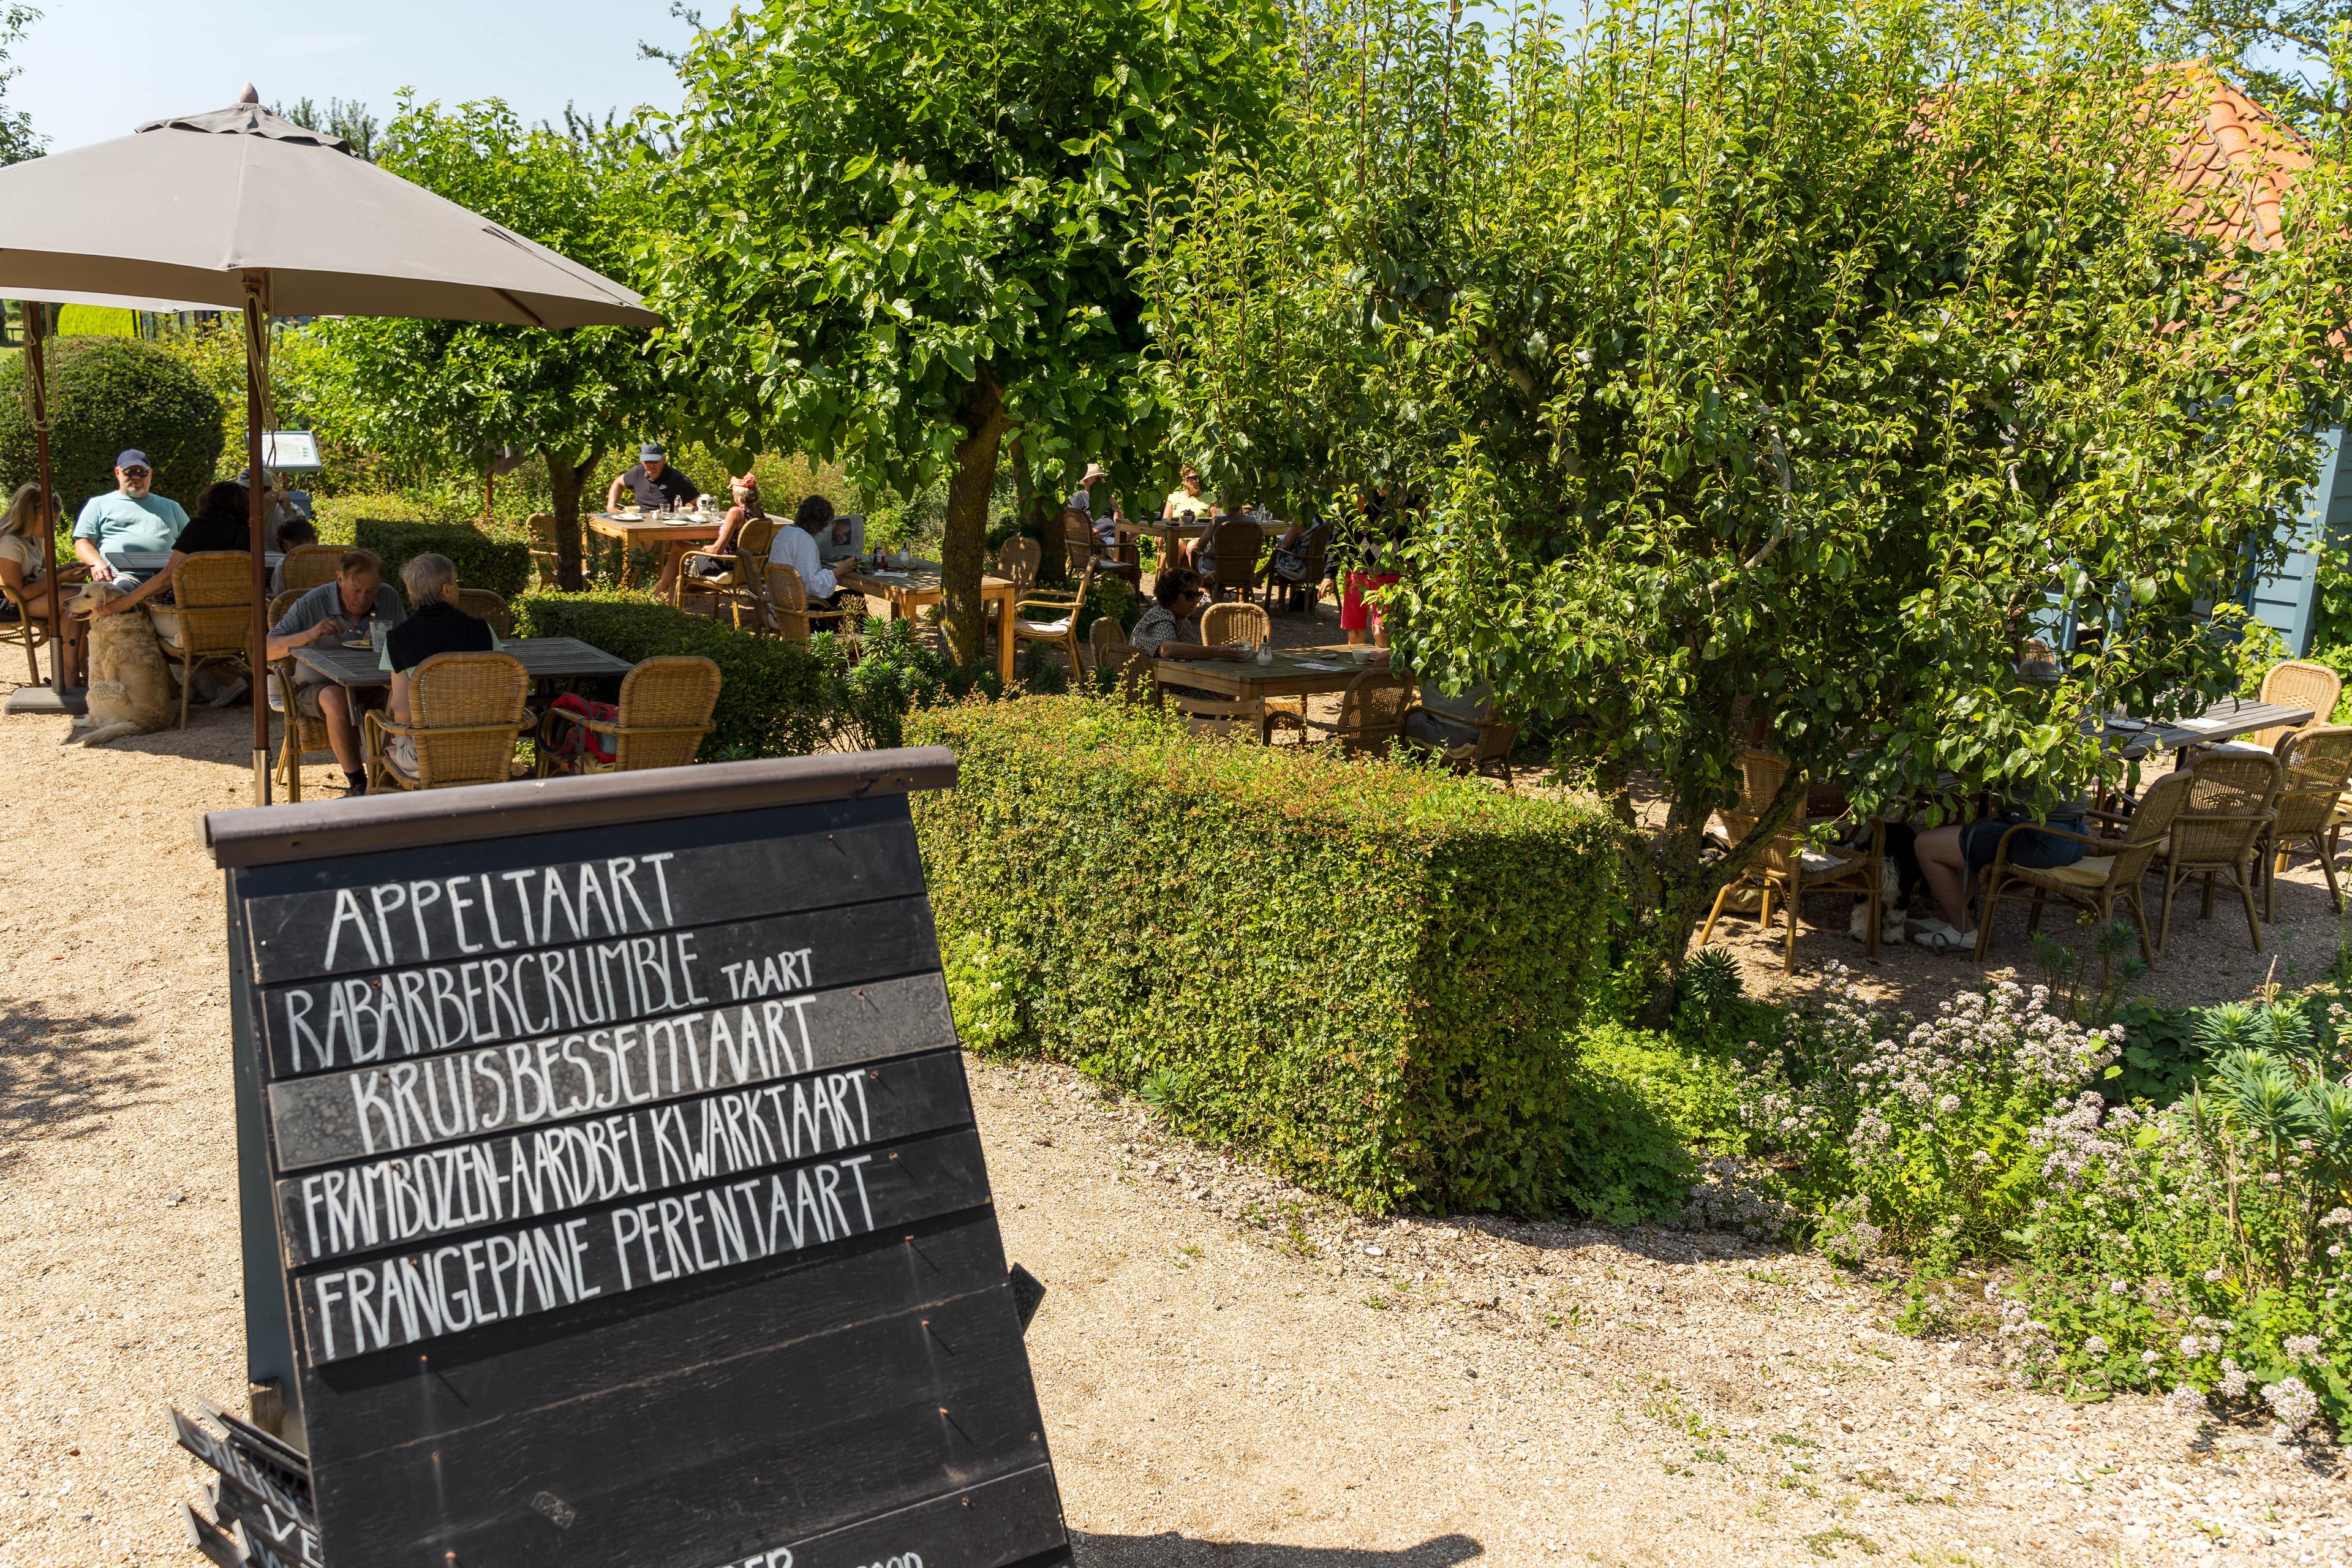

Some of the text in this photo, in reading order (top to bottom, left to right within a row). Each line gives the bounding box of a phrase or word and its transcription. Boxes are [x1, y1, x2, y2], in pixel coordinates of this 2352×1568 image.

[324, 852, 674, 971] APPELTAART
[285, 932, 812, 1072] RABARBERCRUMBLE TAART
[350, 995, 816, 1155] KRUISBESSENTAART
[649, 1069, 871, 1188] KWARKTAART
[314, 1155, 875, 1360] FRANGEPANE PERENTAART
